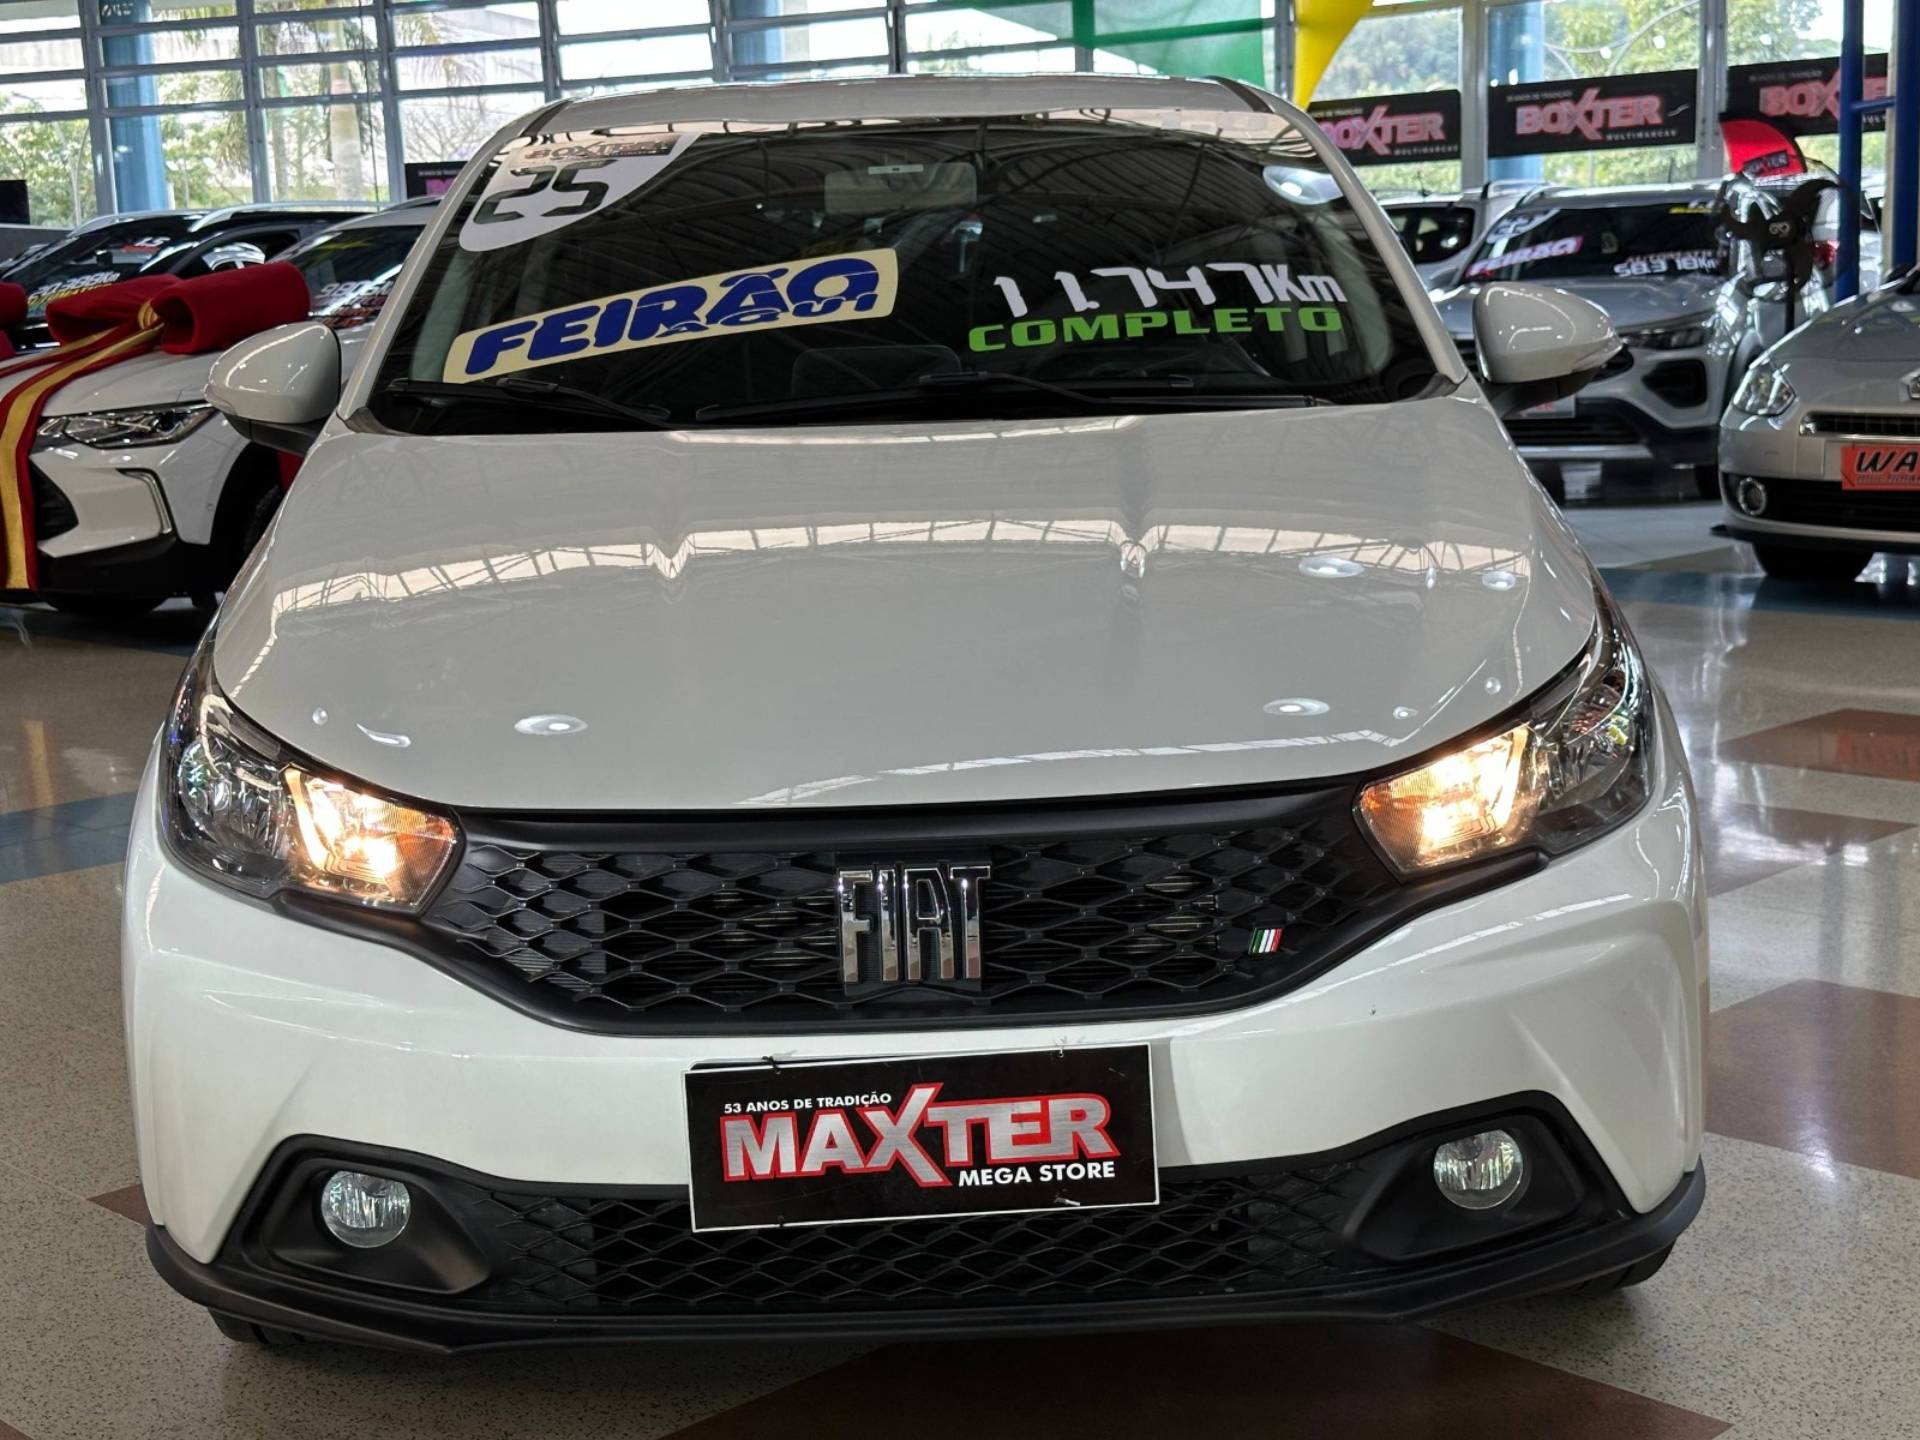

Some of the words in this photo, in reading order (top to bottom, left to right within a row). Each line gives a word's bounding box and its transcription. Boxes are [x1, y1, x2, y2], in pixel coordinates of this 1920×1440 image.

[1516, 87, 1664, 140] BOXTER
[472, 158, 619, 226] 25
[464, 257, 880, 375] FEIRÃO
[968, 307, 1342, 352] COMPLETO
[836, 865, 991, 984] FIAT
[724, 1103, 742, 1114] 53
[746, 1099, 789, 1112] ANOS
[794, 1098, 813, 1110] DE
[816, 1091, 892, 1108] TRADIÇÃO
[720, 1082, 1121, 1188] MAXTER
[958, 1166, 1032, 1187] MEGA
[1039, 1161, 1116, 1182] STORE
